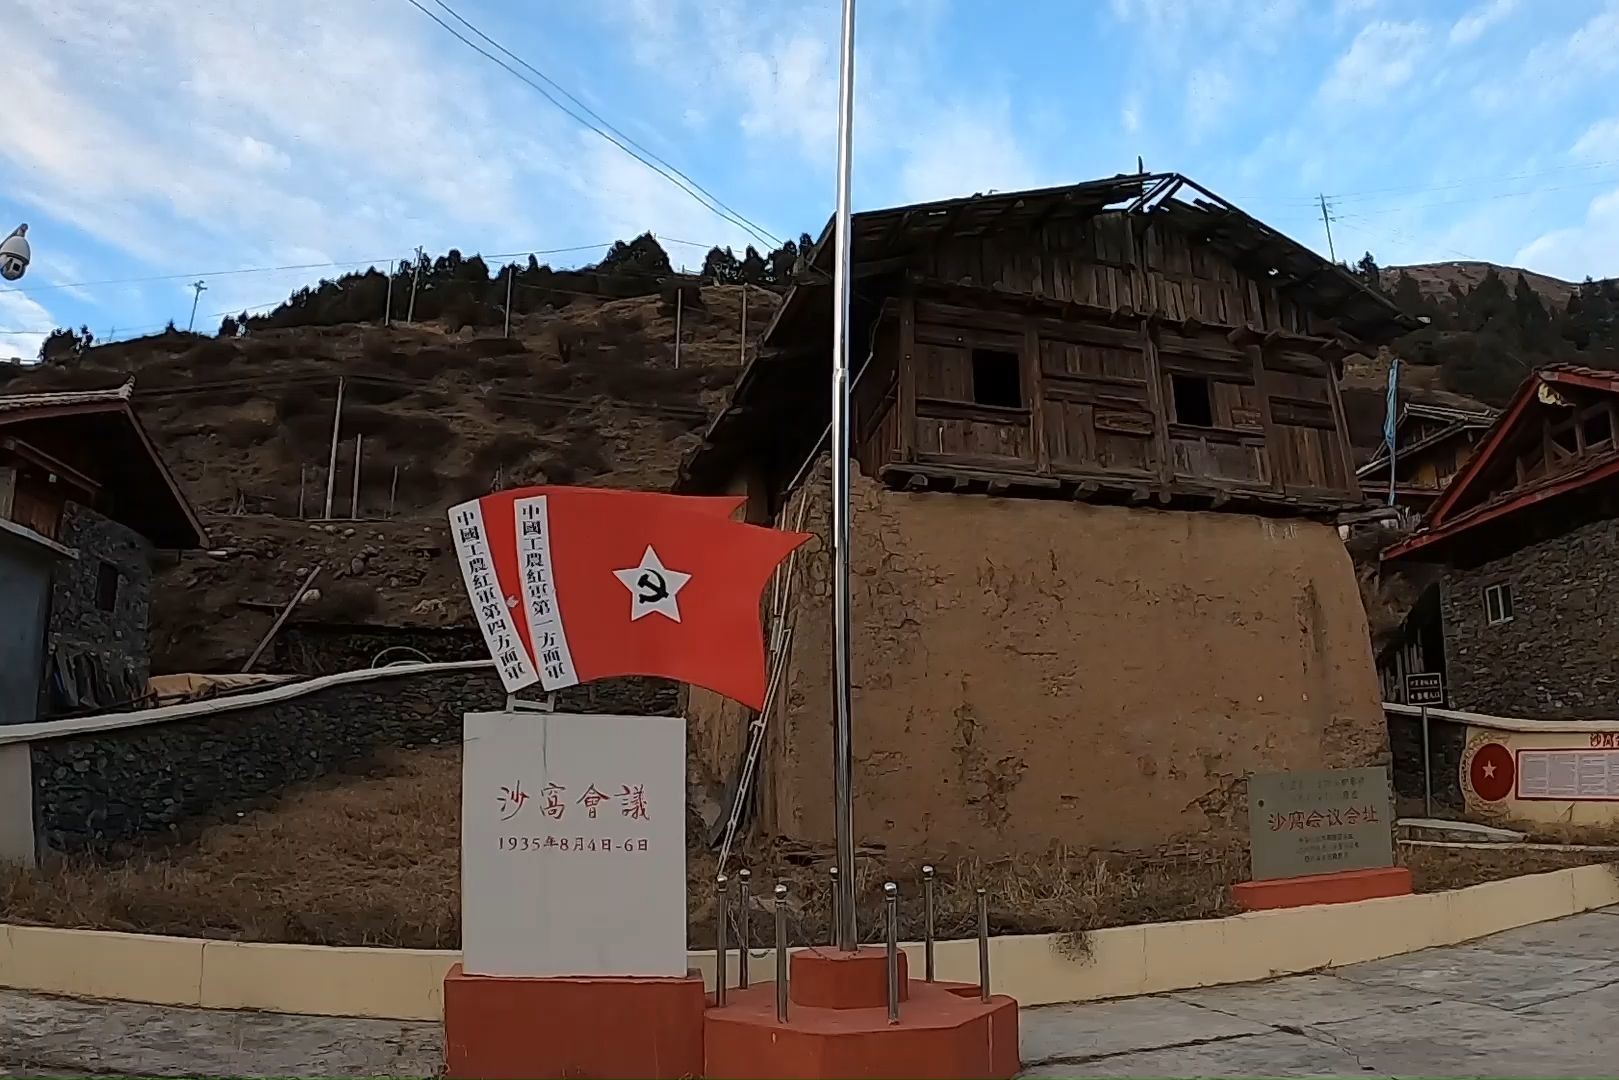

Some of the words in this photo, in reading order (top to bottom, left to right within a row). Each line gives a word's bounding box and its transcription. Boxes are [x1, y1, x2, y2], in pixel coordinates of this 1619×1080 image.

[457, 511, 526, 680] 中國工農紅軍第四方面軍
[522, 504, 565, 679] 中國工農紅軍第一方面軍
[498, 835, 648, 852] 1935年8月4日-6日
